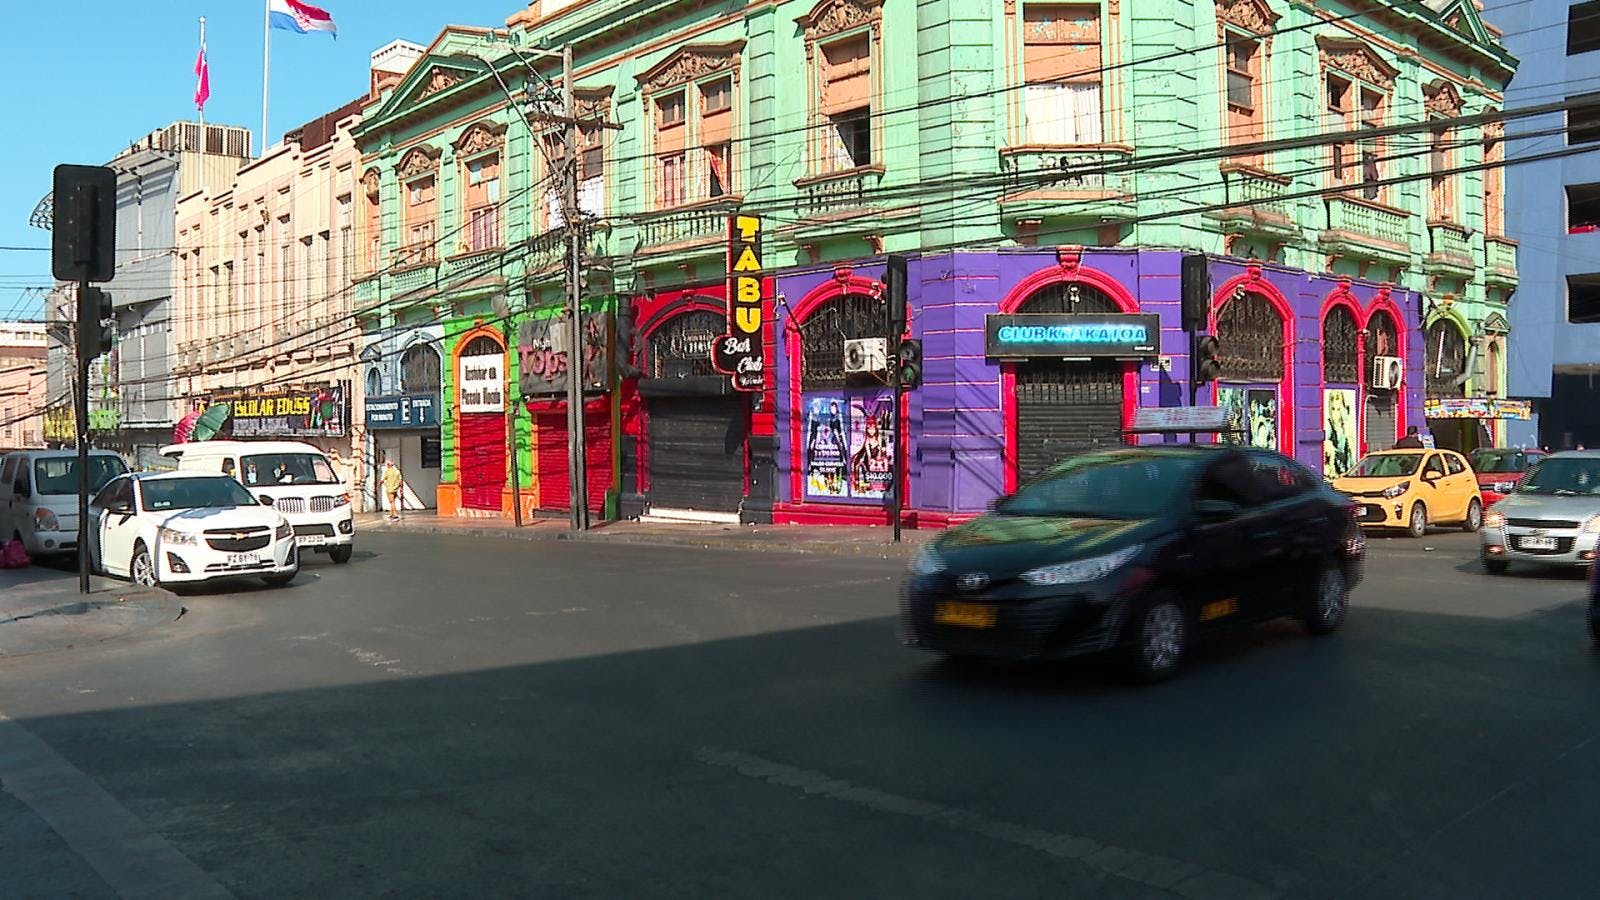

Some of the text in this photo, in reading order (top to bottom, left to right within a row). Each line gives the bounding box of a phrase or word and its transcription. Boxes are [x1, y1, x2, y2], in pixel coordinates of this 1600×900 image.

[733, 216, 762, 333] TABU
[999, 326, 1045, 341] CLUB
[723, 337, 751, 355] Bar
[517, 345, 567, 381] Tops
[737, 356, 763, 374] Club
[234, 399, 273, 416] ESCOLAR
[402, 400, 410, 421] E
